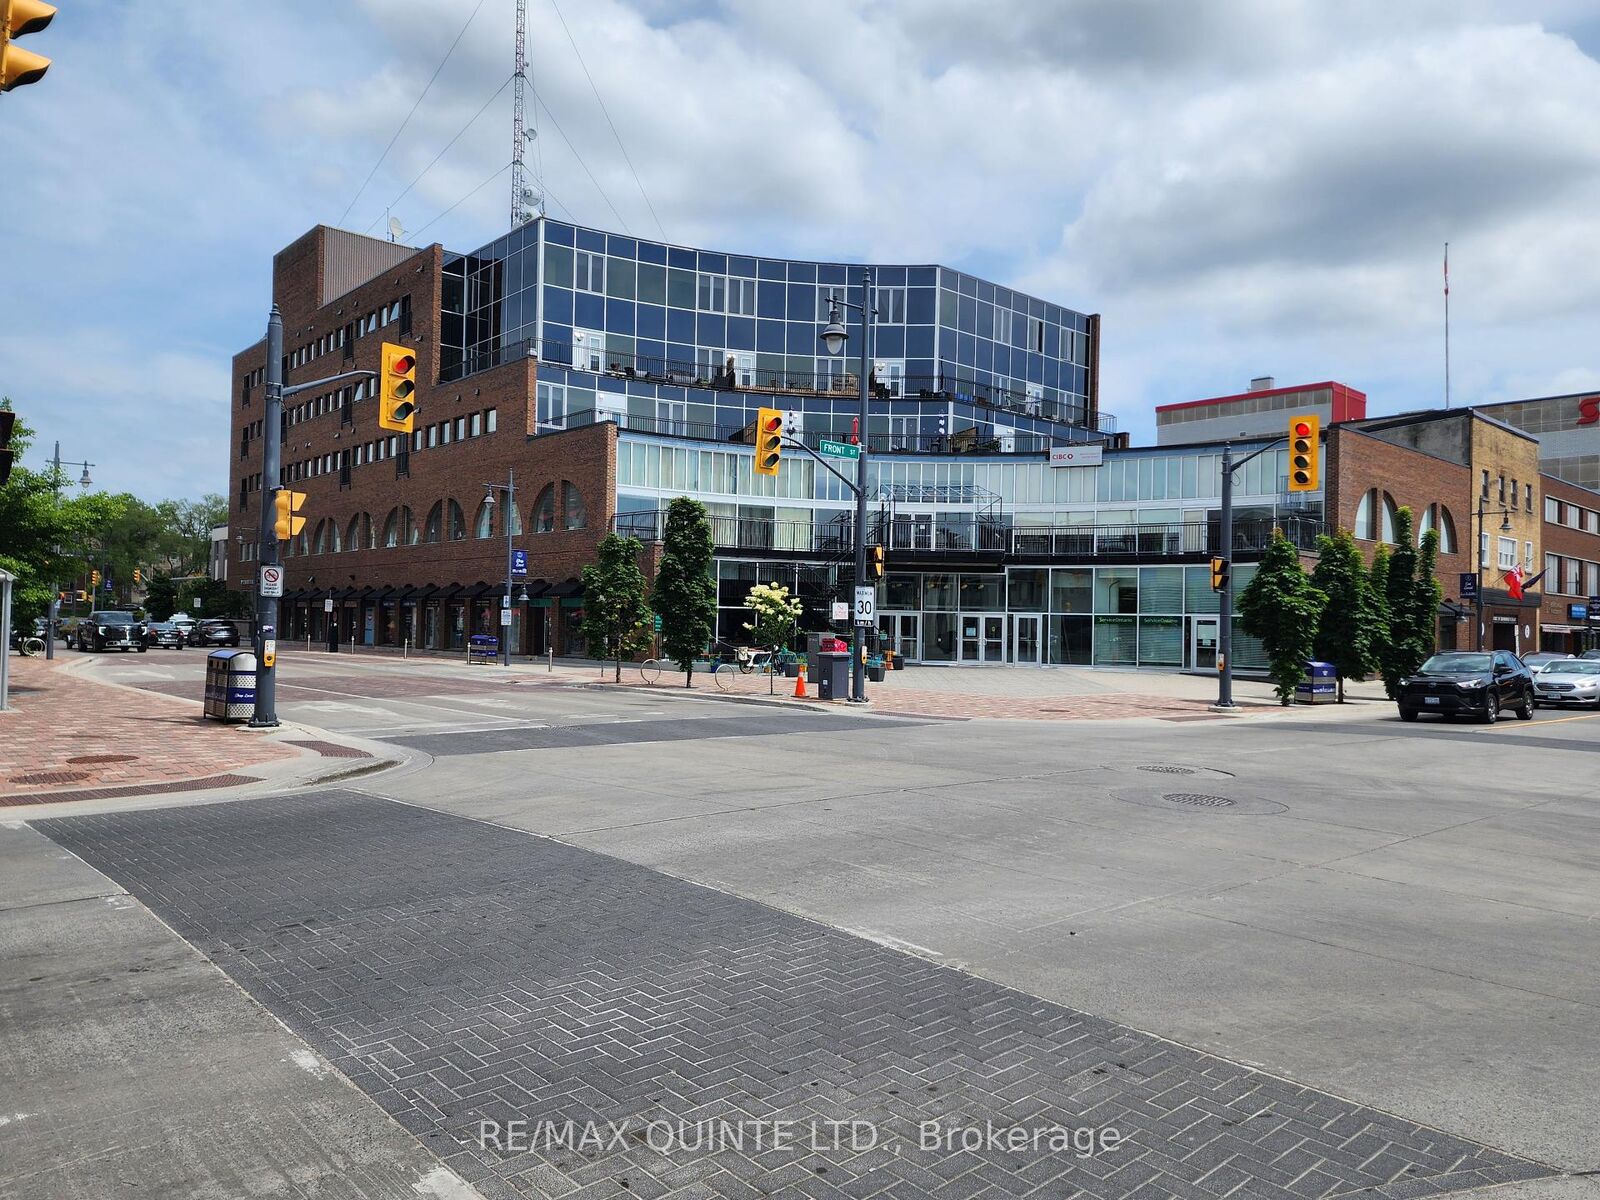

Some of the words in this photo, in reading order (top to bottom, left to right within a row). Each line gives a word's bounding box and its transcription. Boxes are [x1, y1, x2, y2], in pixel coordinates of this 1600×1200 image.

[823, 443, 846, 455] FRONT
[849, 448, 856, 456] ST
[857, 600, 872, 615] 30
